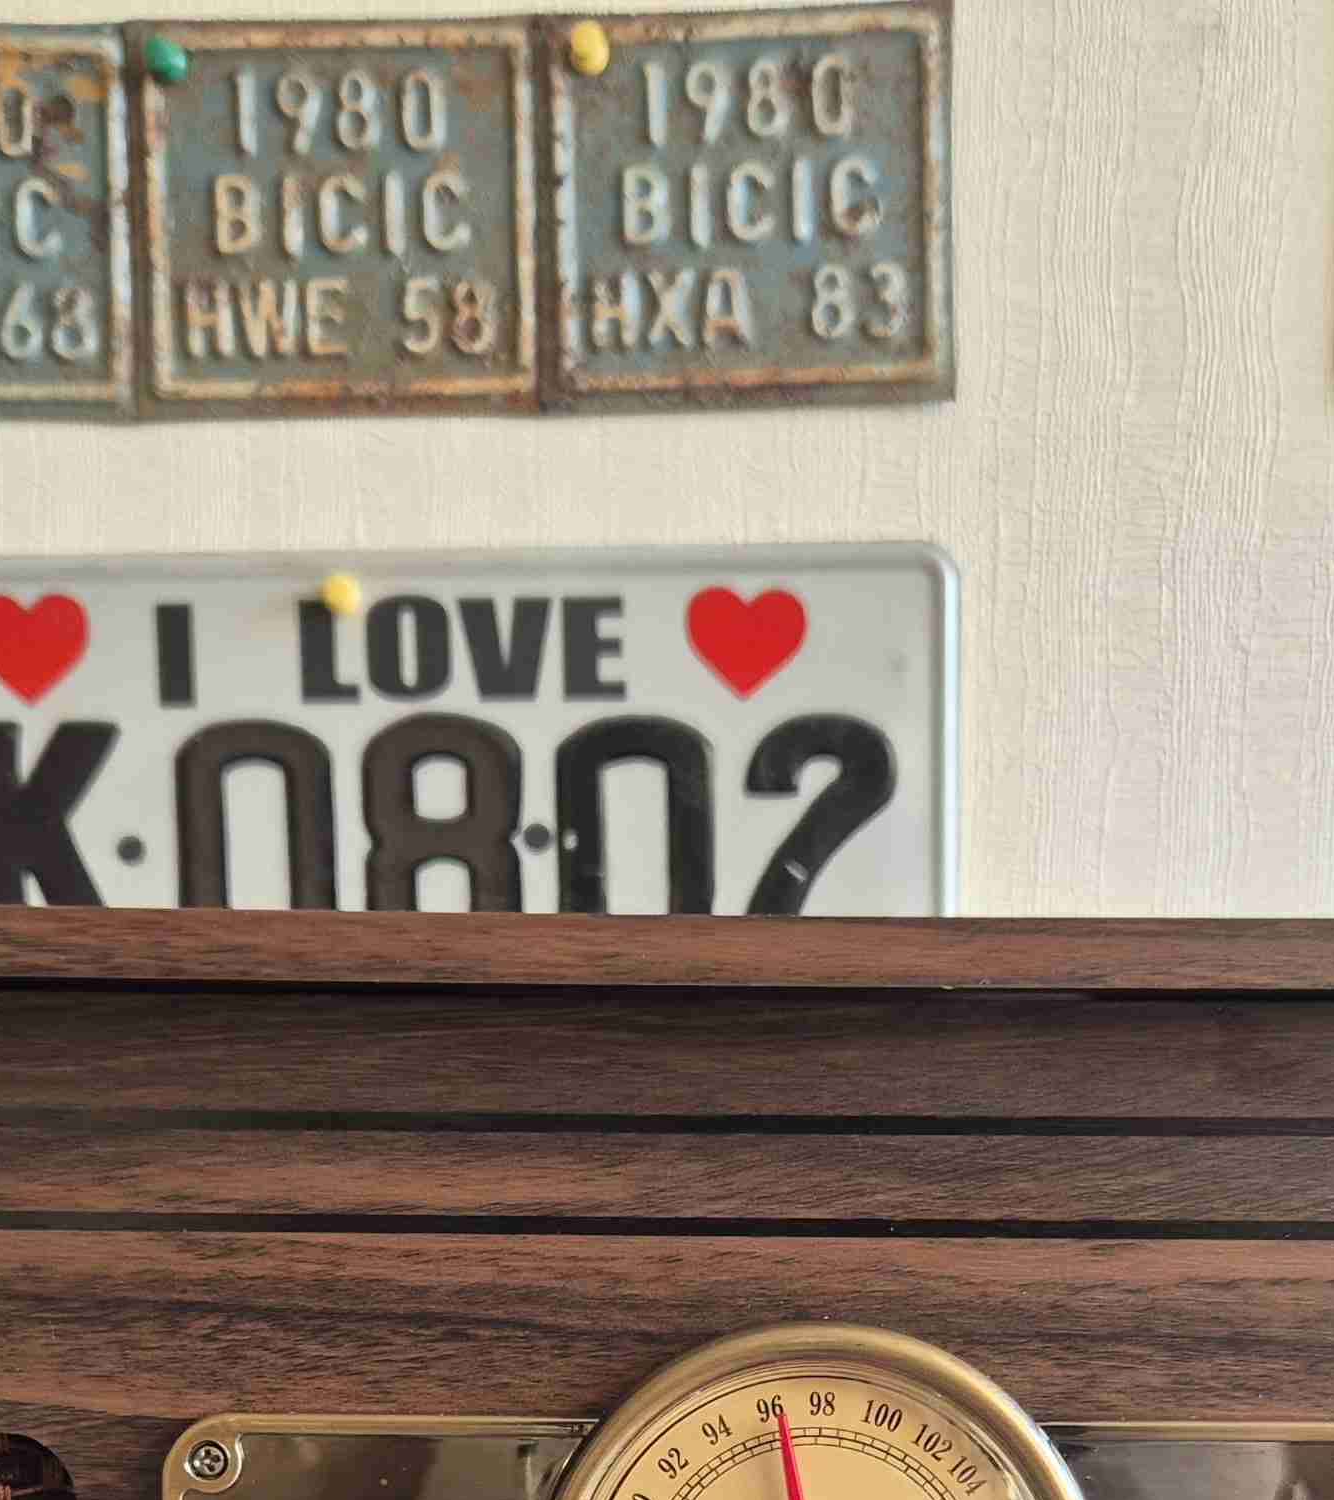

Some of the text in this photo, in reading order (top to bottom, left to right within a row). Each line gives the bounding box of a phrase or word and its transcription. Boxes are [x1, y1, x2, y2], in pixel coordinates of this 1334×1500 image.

[234, 68, 447, 157] 1980
[643, 52, 856, 147] 1980
[215, 171, 471, 259] BICIC
[623, 156, 883, 249] BICIC
[186, 277, 495, 359] HWE 58
[592, 263, 907, 352] HXA 83
[156, 595, 626, 707] I LOVE
[657, 1446, 689, 1480] 92
[700, 1413, 733, 1446] 94
[756, 1394, 786, 1423] 96
[809, 1391, 836, 1417] 98
[860, 1399, 905, 1433] 100
[911, 1422, 954, 1462] 102
[945, 1455, 988, 1497] 104
